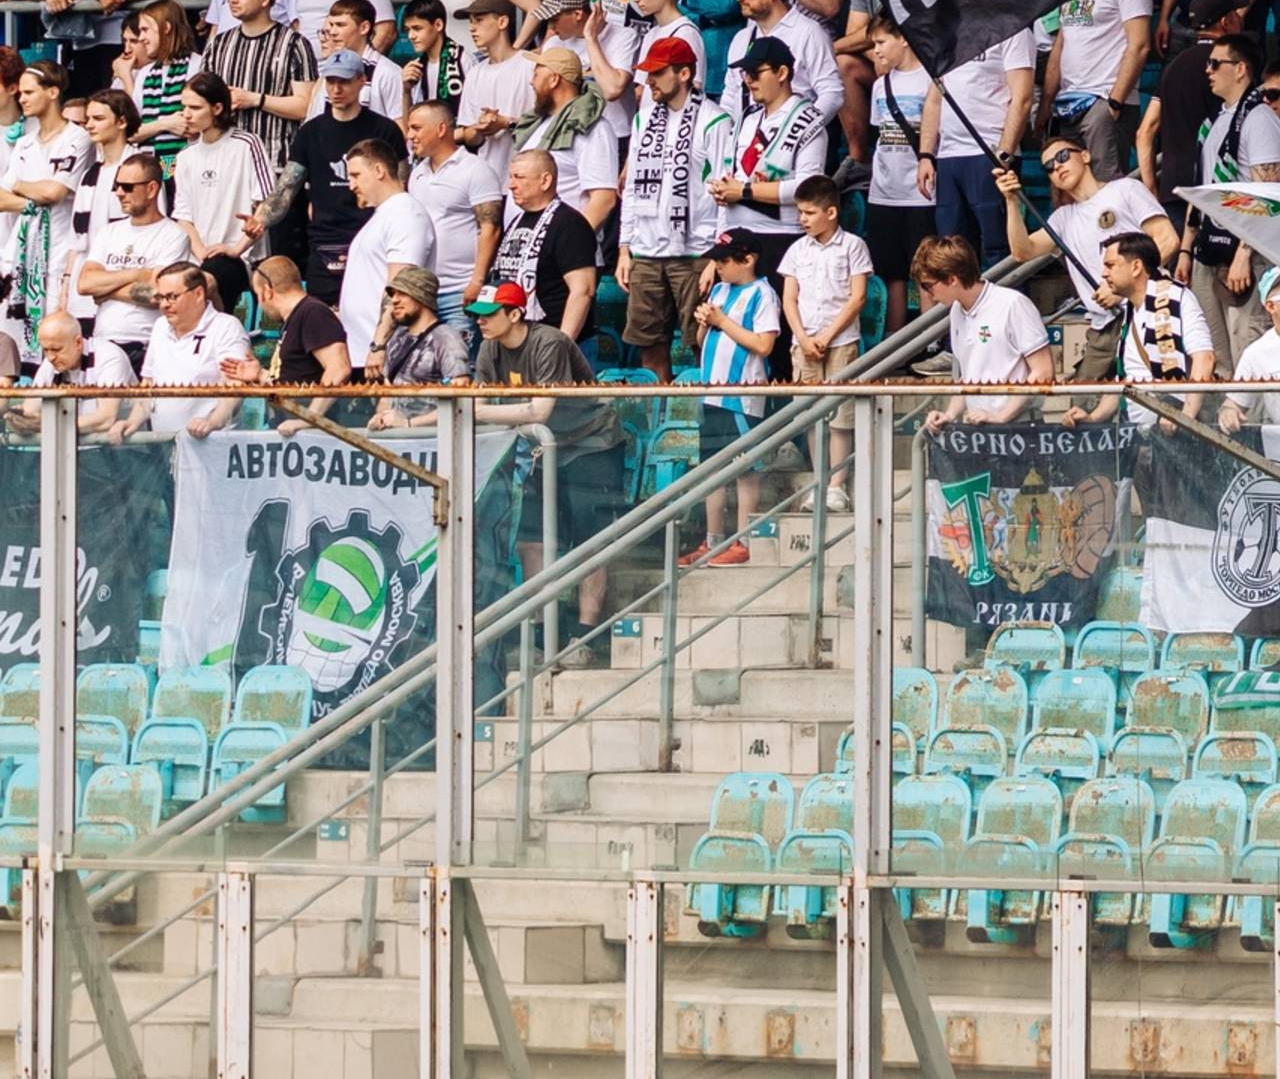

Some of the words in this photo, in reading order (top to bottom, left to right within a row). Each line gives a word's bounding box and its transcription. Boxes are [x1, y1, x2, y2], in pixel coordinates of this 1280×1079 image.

[1053, 331, 1062, 342] 9
[193, 335, 206, 355] Т
[768, 521, 778, 534] 7
[972, 602, 1074, 625] РЯЗАНЬ
[632, 623, 641, 634] 6
[484, 727, 492, 739] 5
[339, 825, 347, 837] 4
